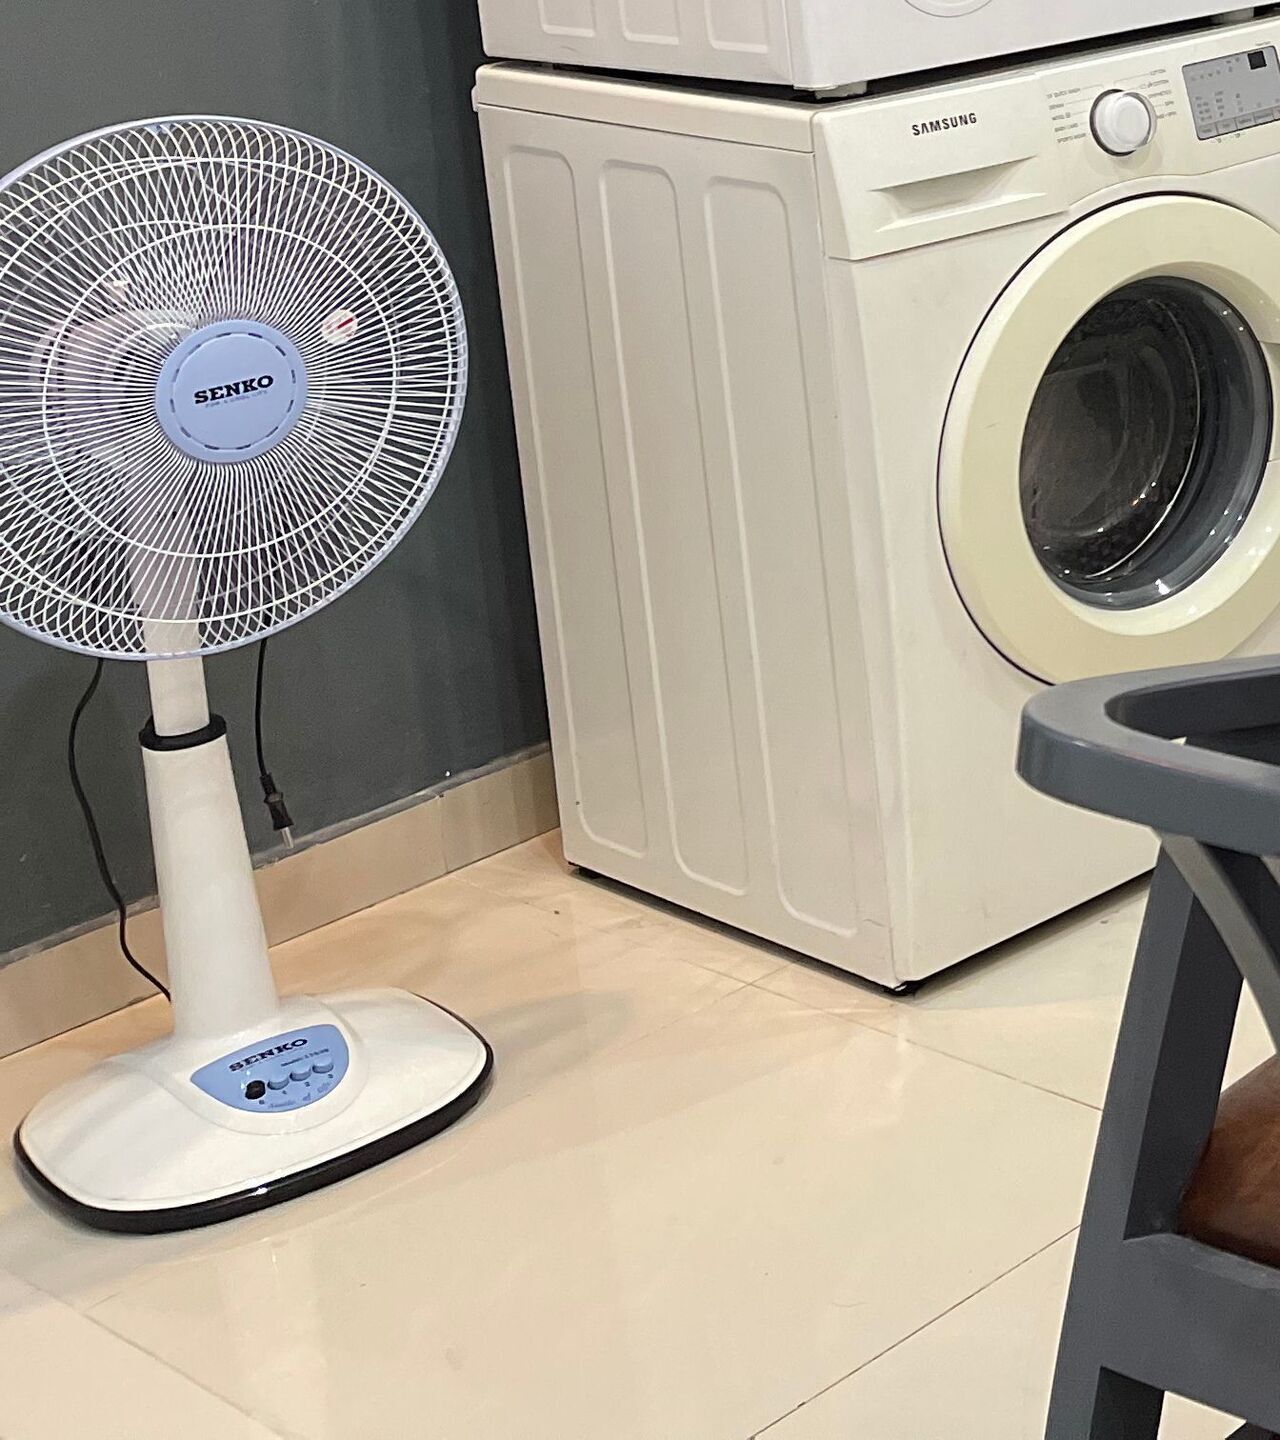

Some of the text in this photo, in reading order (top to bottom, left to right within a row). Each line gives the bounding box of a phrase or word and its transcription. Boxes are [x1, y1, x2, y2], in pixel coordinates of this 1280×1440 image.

[911, 112, 978, 137] SAMSUNG
[193, 375, 274, 405] SENKO
[228, 1038, 308, 1072] SENKO
